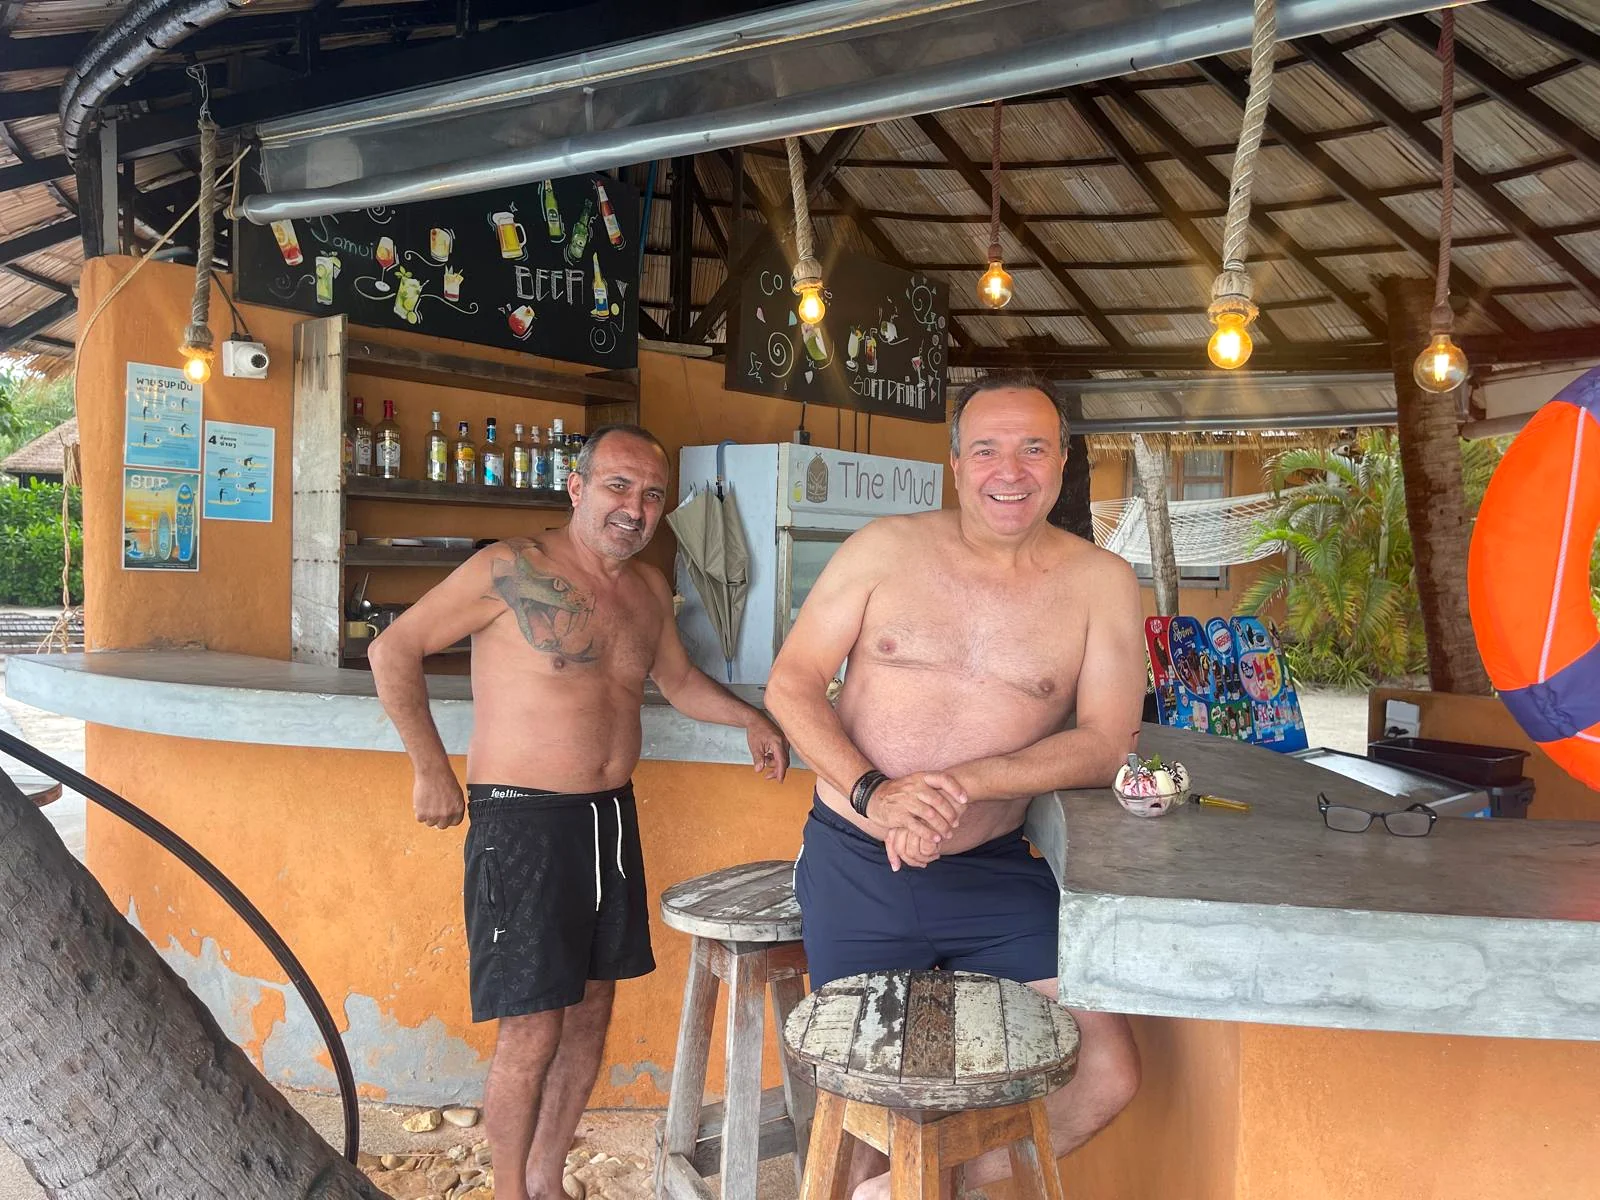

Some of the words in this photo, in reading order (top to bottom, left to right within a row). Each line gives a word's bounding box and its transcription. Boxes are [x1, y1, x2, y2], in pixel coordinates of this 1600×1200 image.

[514, 264, 585, 305] BEER
[158, 379, 176, 389] SUP
[849, 374, 886, 401] SOFT
[208, 435, 217, 445] 4
[131, 475, 168, 488] SUP
[838, 461, 884, 500] The
[893, 466, 935, 506] Mud
